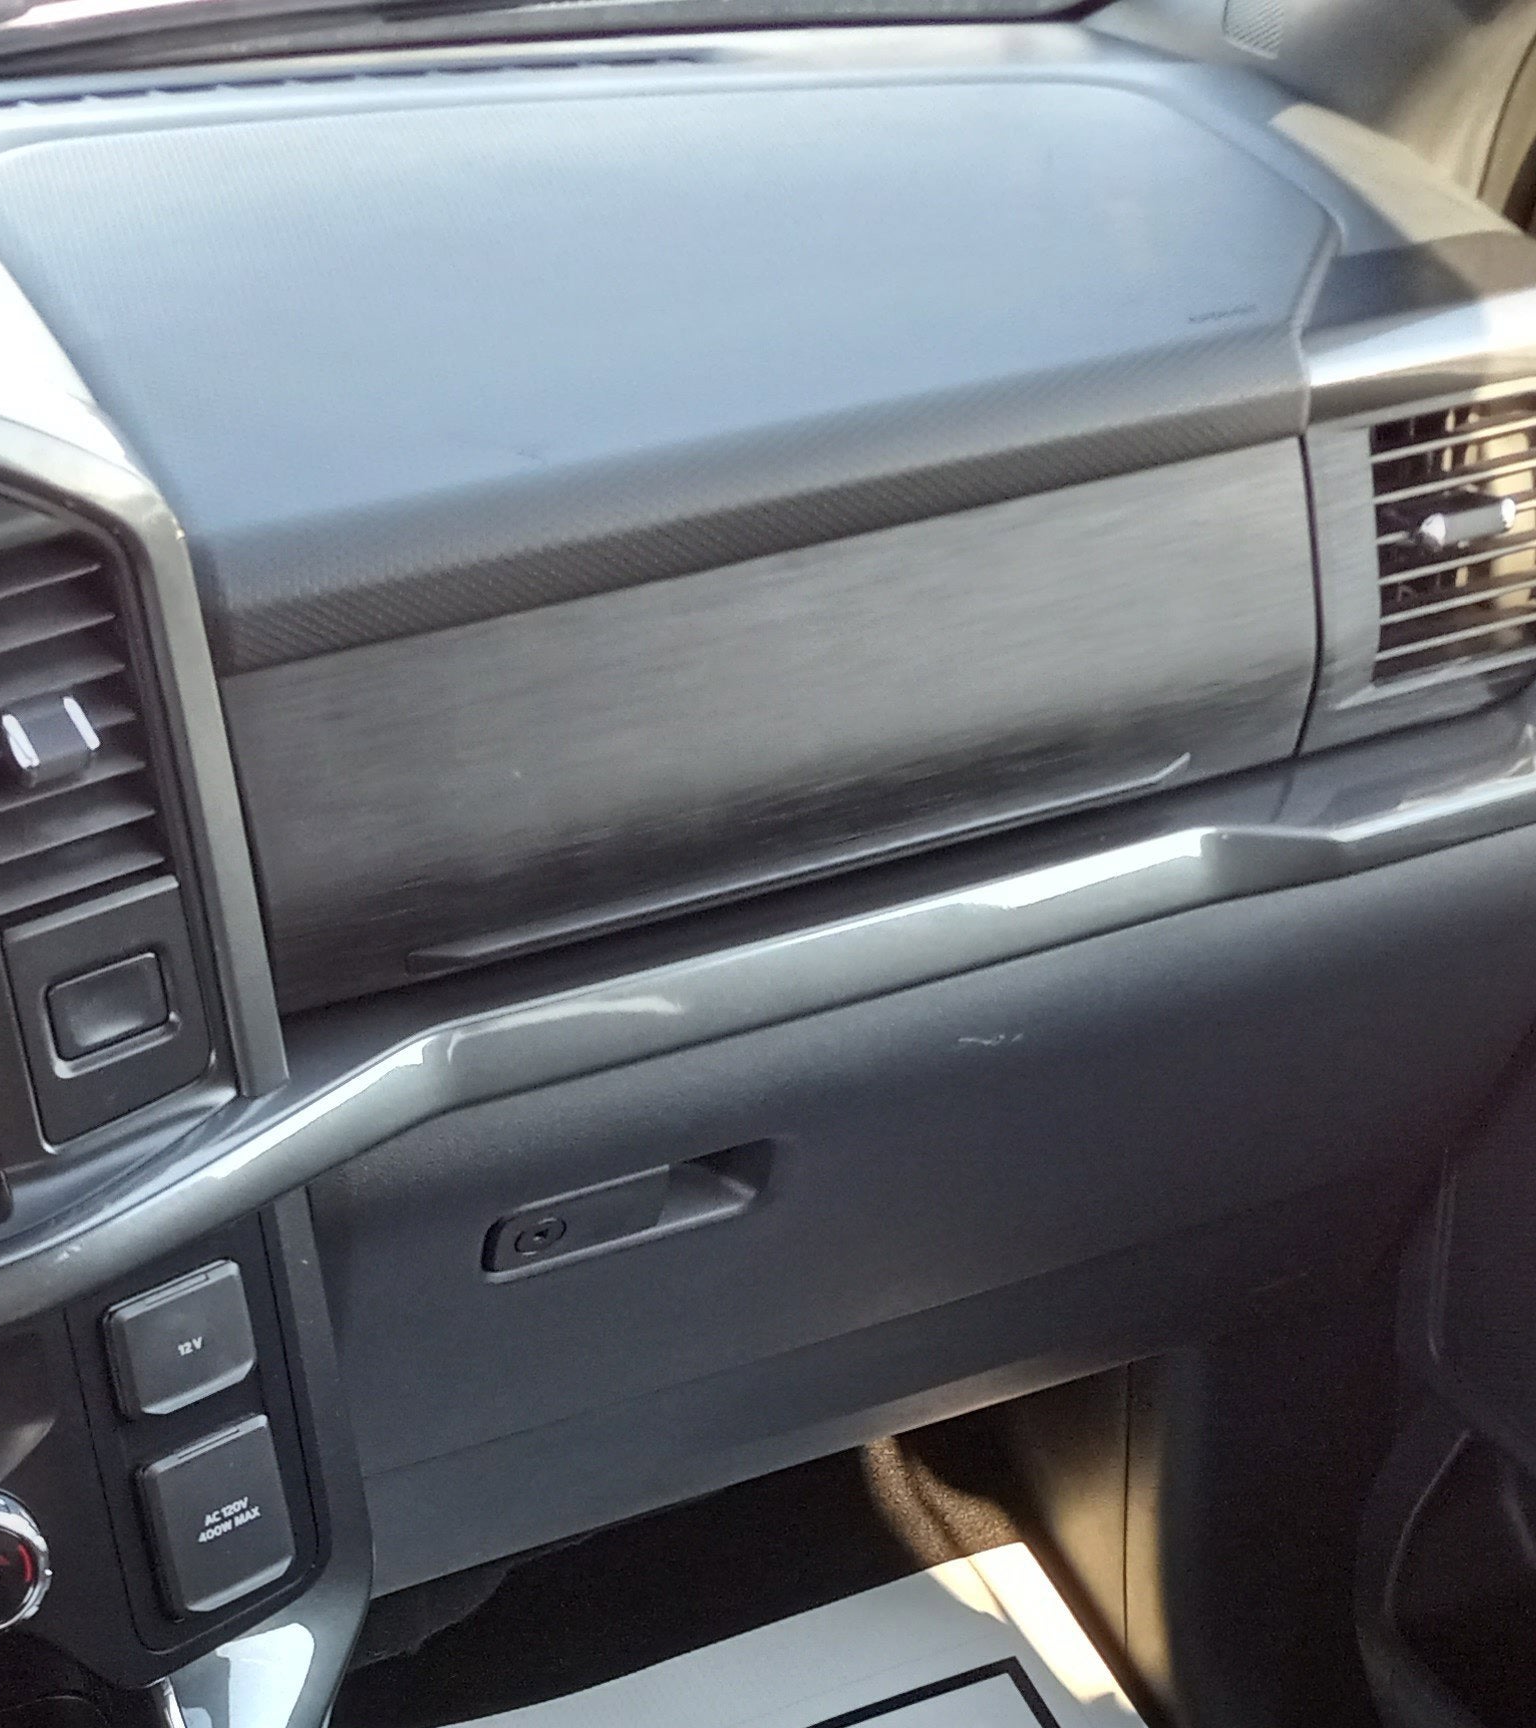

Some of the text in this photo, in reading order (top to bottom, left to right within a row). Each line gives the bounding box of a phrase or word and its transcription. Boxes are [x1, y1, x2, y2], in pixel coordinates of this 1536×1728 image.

[197, 1505, 262, 1544] 400W MAX
[203, 1497, 249, 1528] AC 120V
